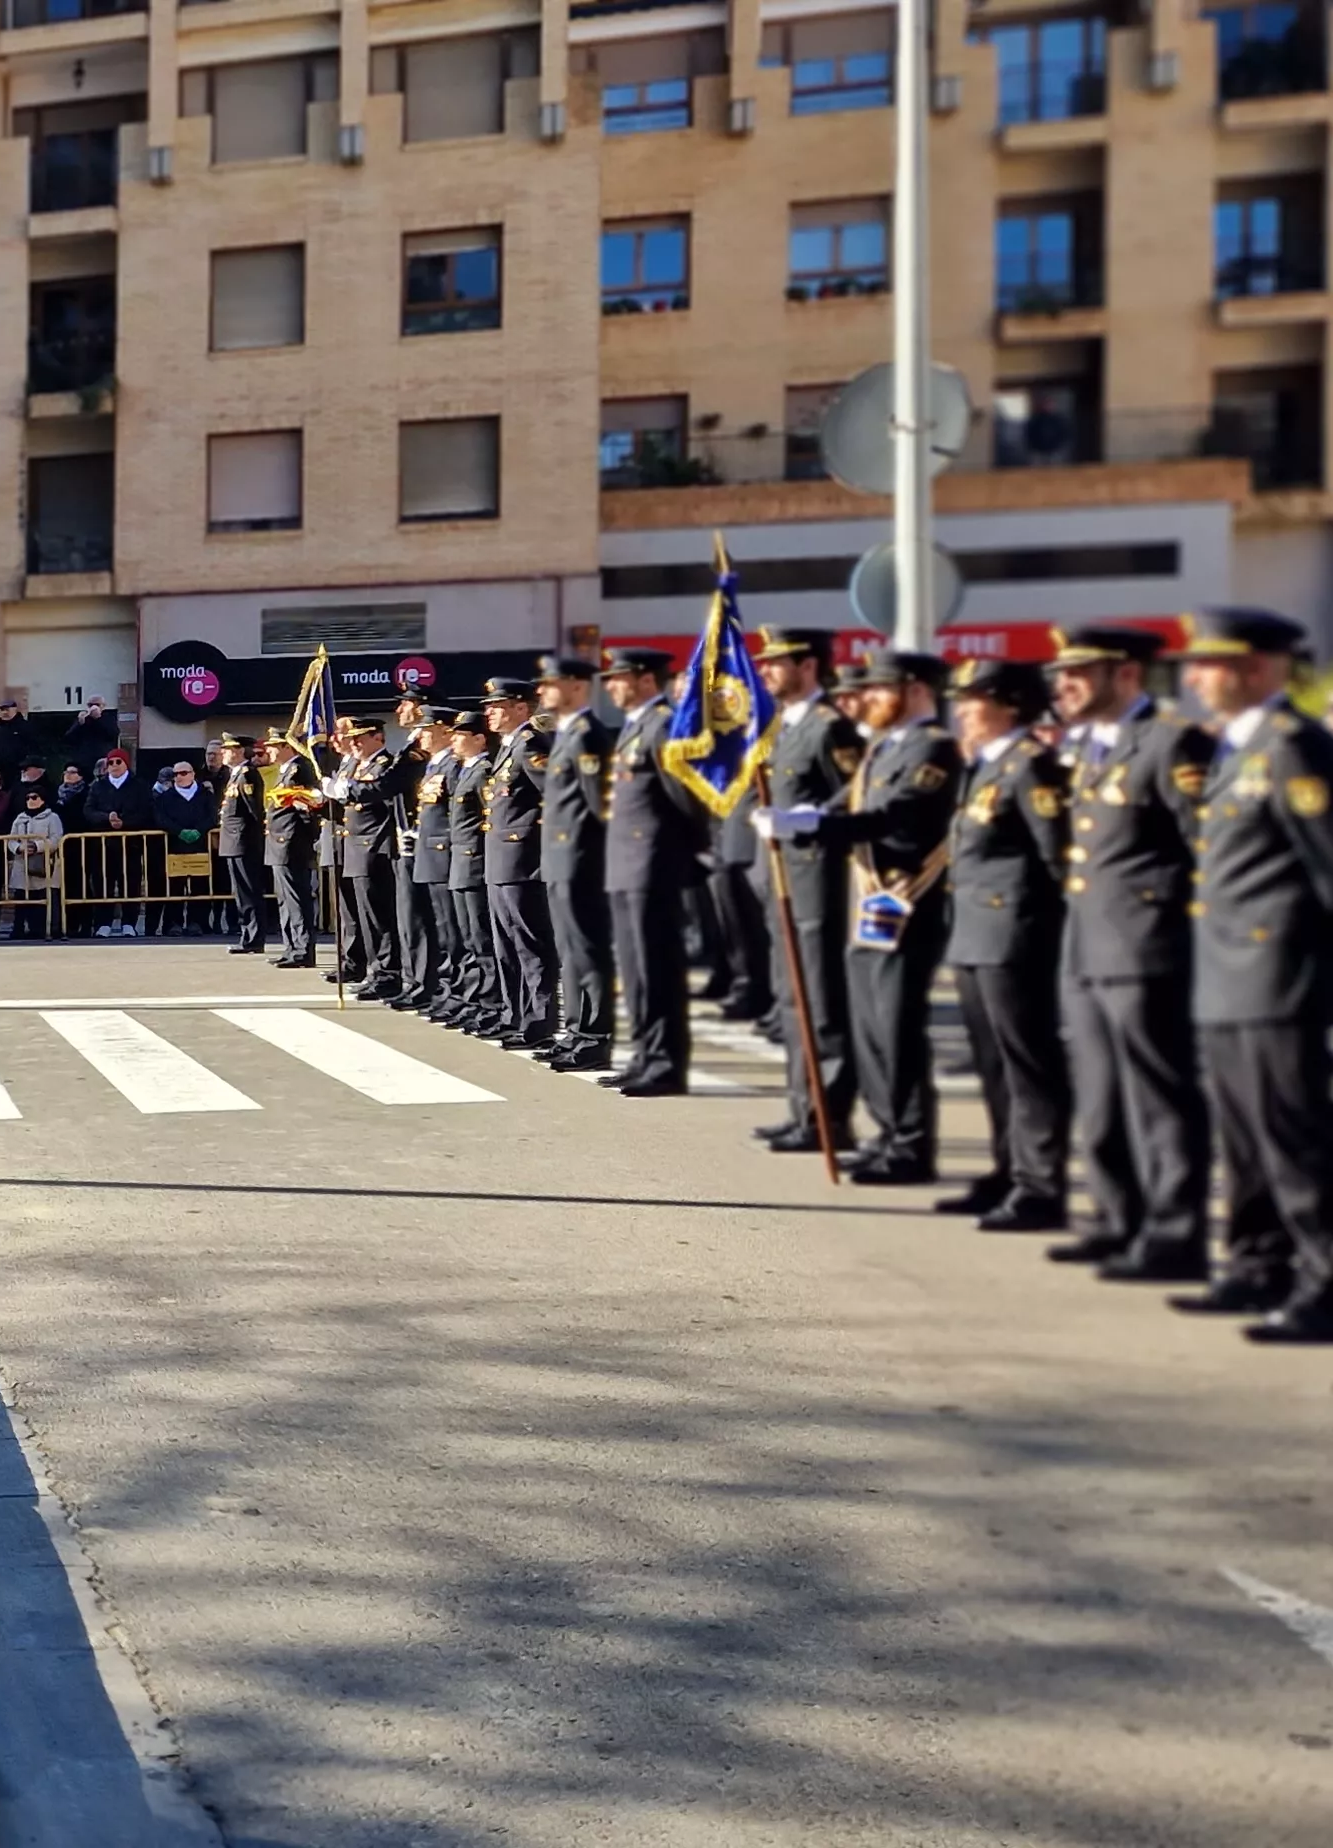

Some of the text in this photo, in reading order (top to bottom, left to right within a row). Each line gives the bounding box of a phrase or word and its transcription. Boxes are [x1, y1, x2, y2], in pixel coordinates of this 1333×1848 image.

[851, 632, 1009, 660] MFRE
[160, 664, 206, 678] moda
[341, 669, 390, 683] moda
[64, 686, 83, 704] 11
